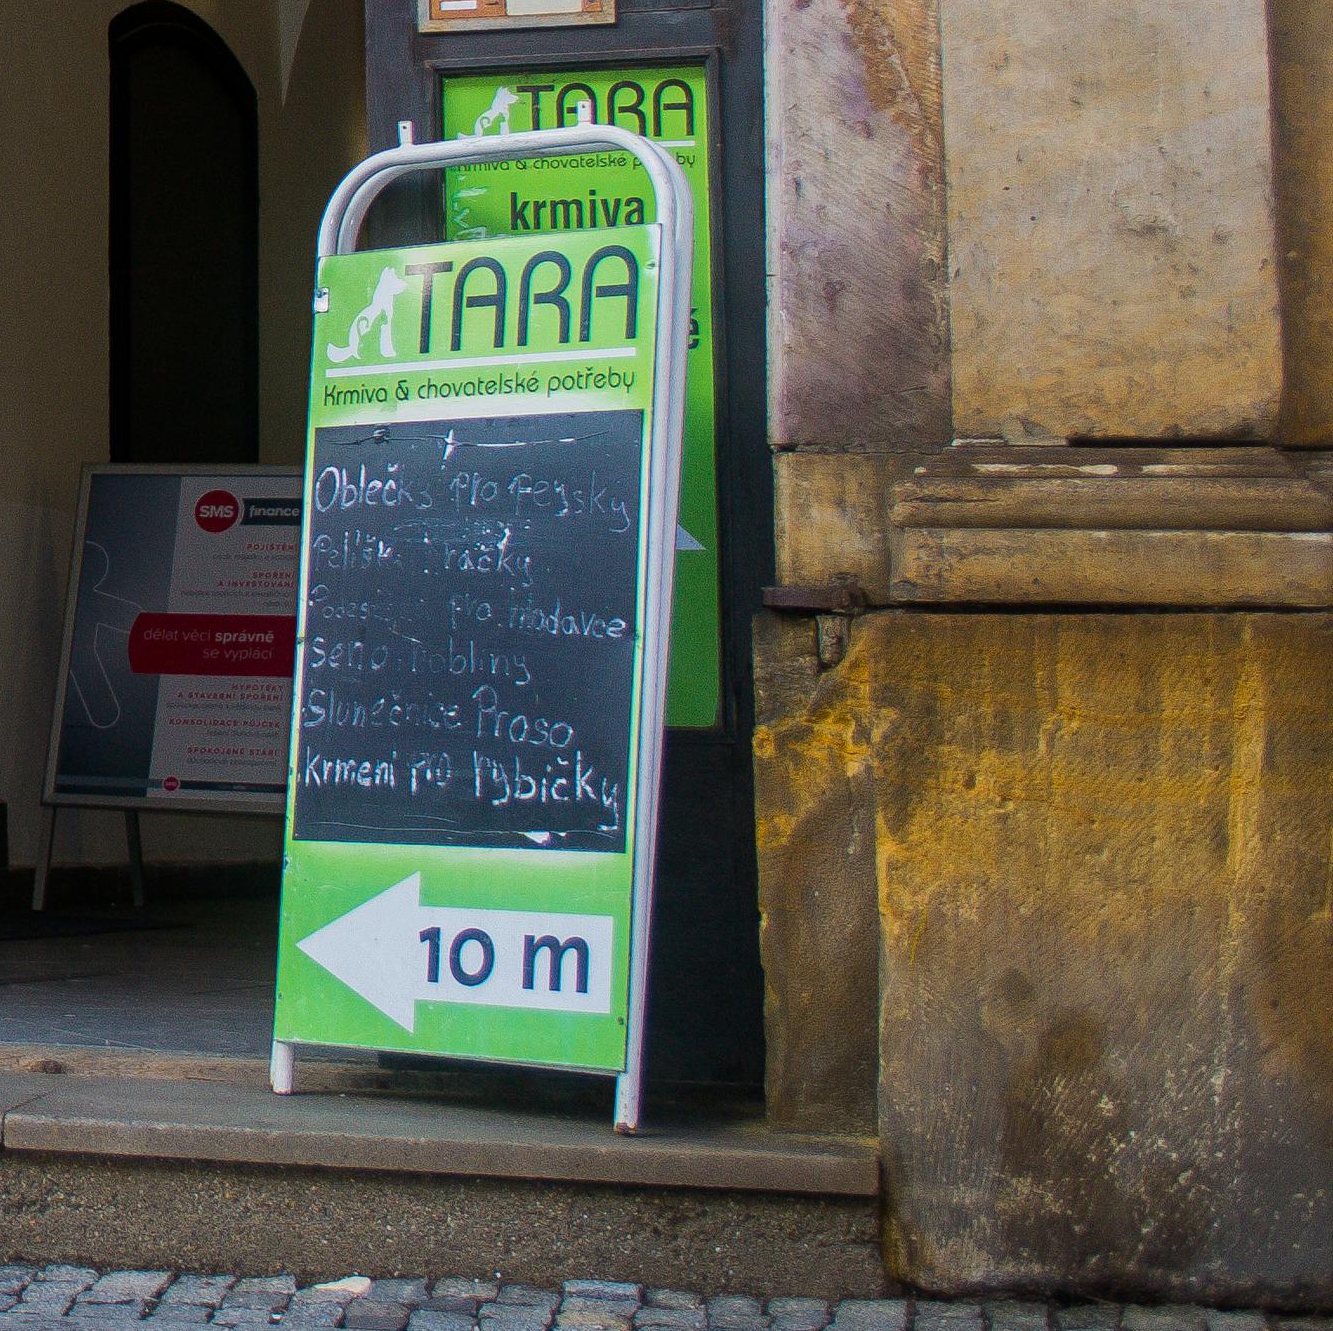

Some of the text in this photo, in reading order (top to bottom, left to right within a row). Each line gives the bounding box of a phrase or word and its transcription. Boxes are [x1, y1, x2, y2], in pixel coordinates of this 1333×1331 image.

[517, 78, 695, 137] TARA
[515, 158, 527, 170] &
[533, 153, 627, 169] chovatelské
[510, 190, 645, 230] krmiva
[404, 245, 640, 354] TARA
[324, 365, 635, 406] Krmiva & chovatelské potřeby
[199, 504, 300, 519] SMS finance
[143, 629, 275, 645] dělat věci správně
[202, 646, 273, 661] se vyplácí
[419, 926, 590, 994] 10 m
